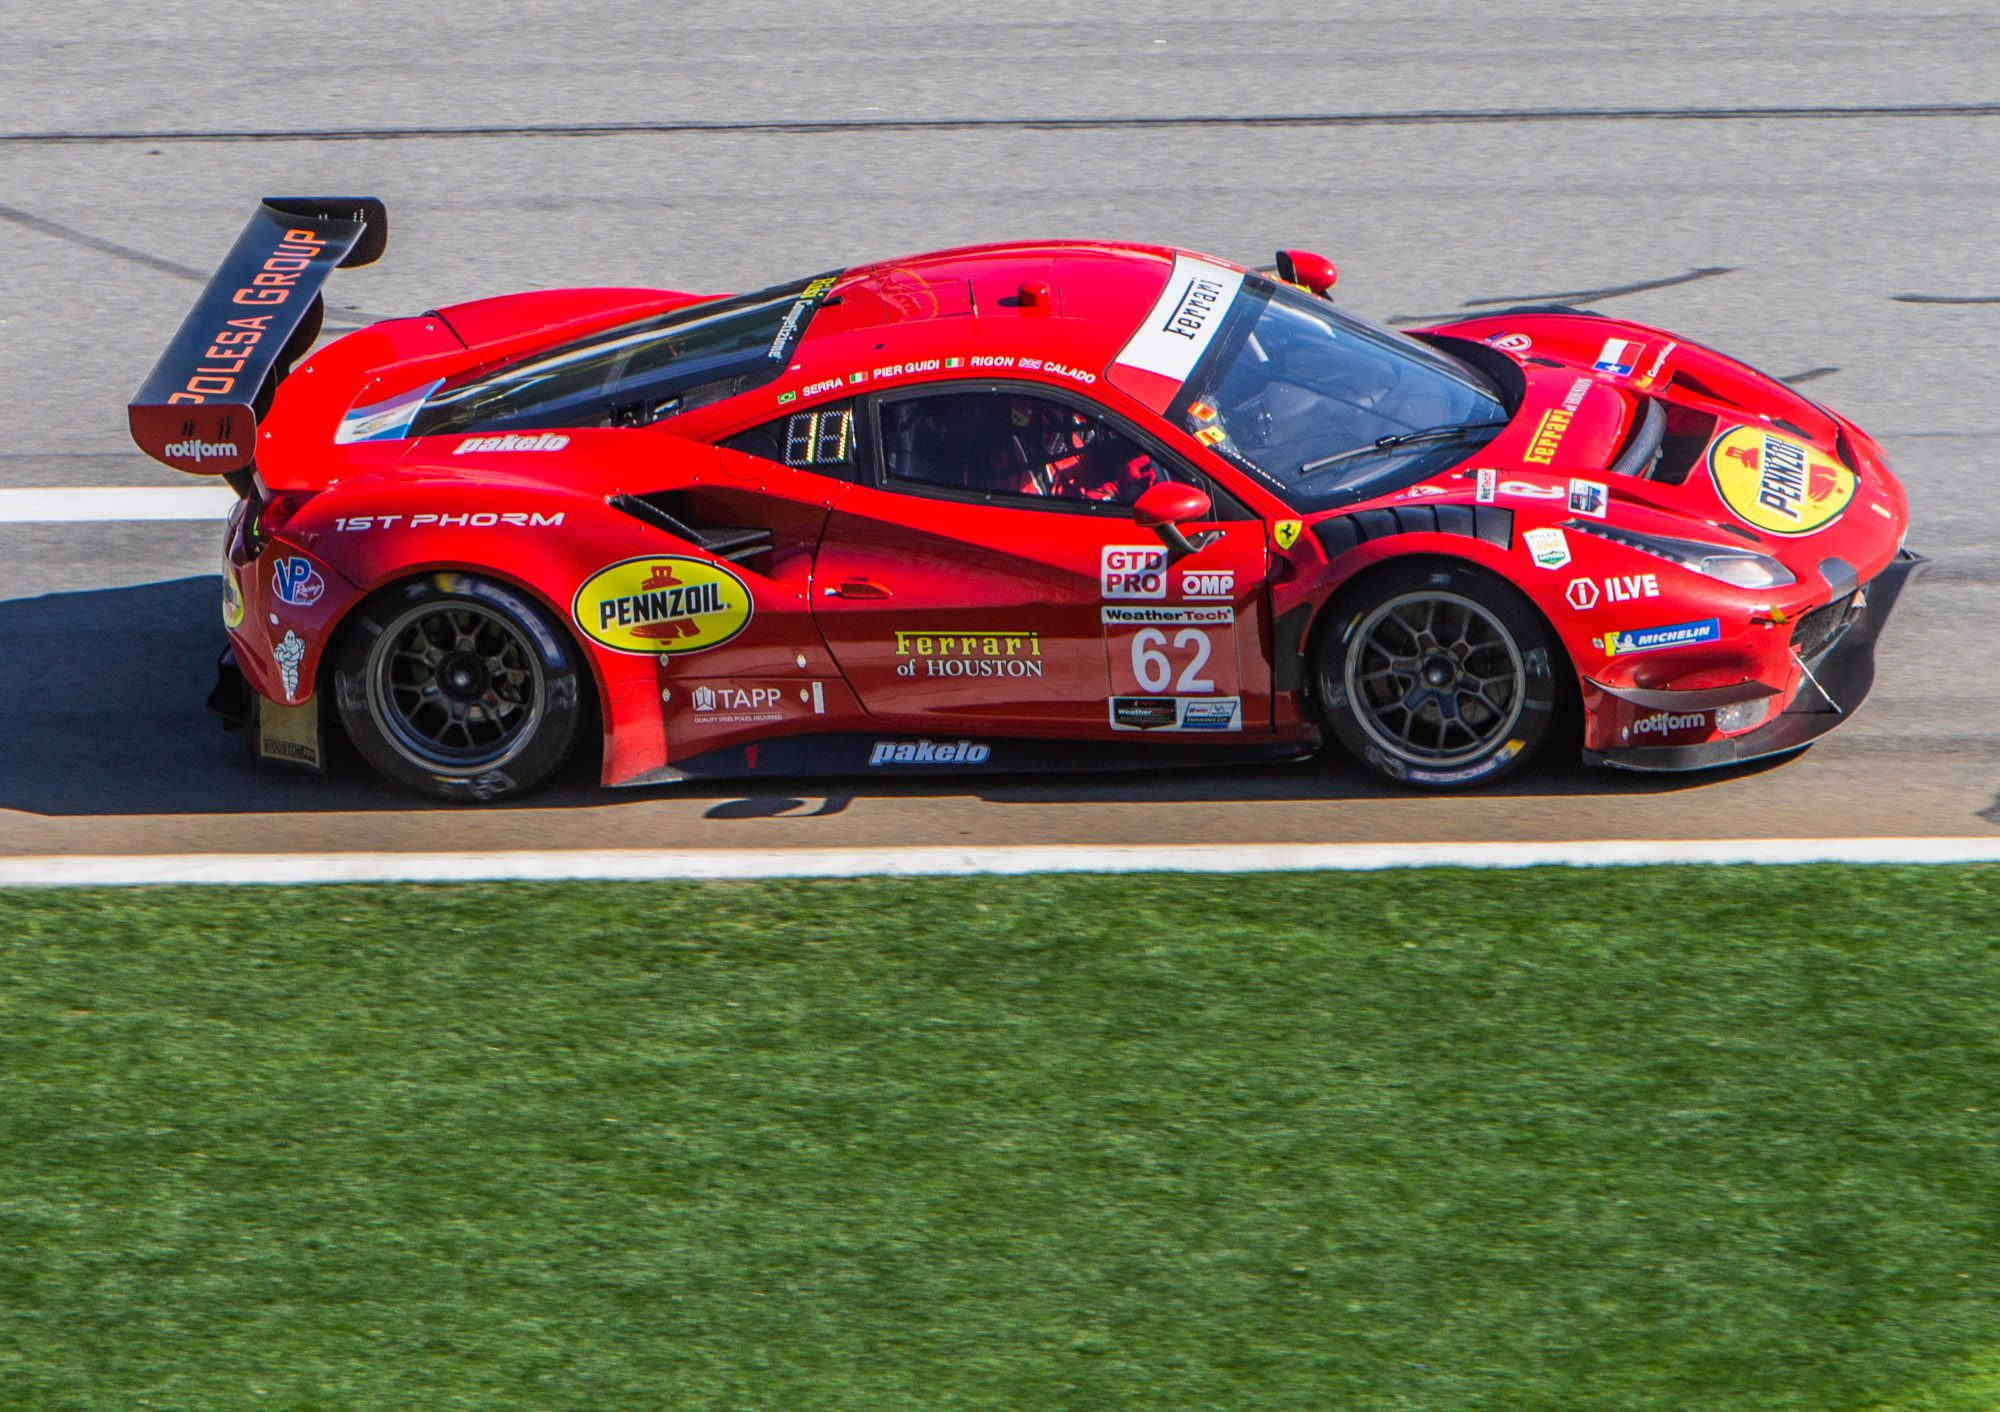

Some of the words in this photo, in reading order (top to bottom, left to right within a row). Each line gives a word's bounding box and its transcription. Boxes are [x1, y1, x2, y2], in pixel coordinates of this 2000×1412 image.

[232, 229, 326, 305] GROUP
[1163, 277, 1223, 340] Ferrari
[803, 377, 843, 397] SERRA
[873, 365, 902, 379] PIER
[904, 359, 940, 374] GUIDI
[970, 356, 1014, 367] RIGON
[1043, 361, 1096, 384] CALADO
[452, 432, 571, 455] pakelo
[1523, 408, 1575, 464] Ferrari
[165, 440, 238, 462] rotiform
[335, 515, 402, 532] 1ST
[410, 512, 565, 528] PHORM
[1106, 551, 1163, 571] GTD
[273, 556, 312, 604] VP
[1106, 573, 1161, 593] PRO
[1182, 575, 1235, 595] OMP
[1604, 573, 1660, 603] ILVE
[599, 582, 725, 633] PENNZOIL
[1106, 608, 1230, 621] WeatherTech
[895, 631, 1041, 655] Ferrari
[1638, 626, 1711, 645] MICHELIN
[896, 658, 917, 676] of
[926, 659, 1042, 677] HOUSTON
[1131, 628, 1215, 693] 62
[717, 688, 782, 709] TAPP
[1633, 712, 1706, 736] rotiform
[869, 740, 991, 765] pakelo
